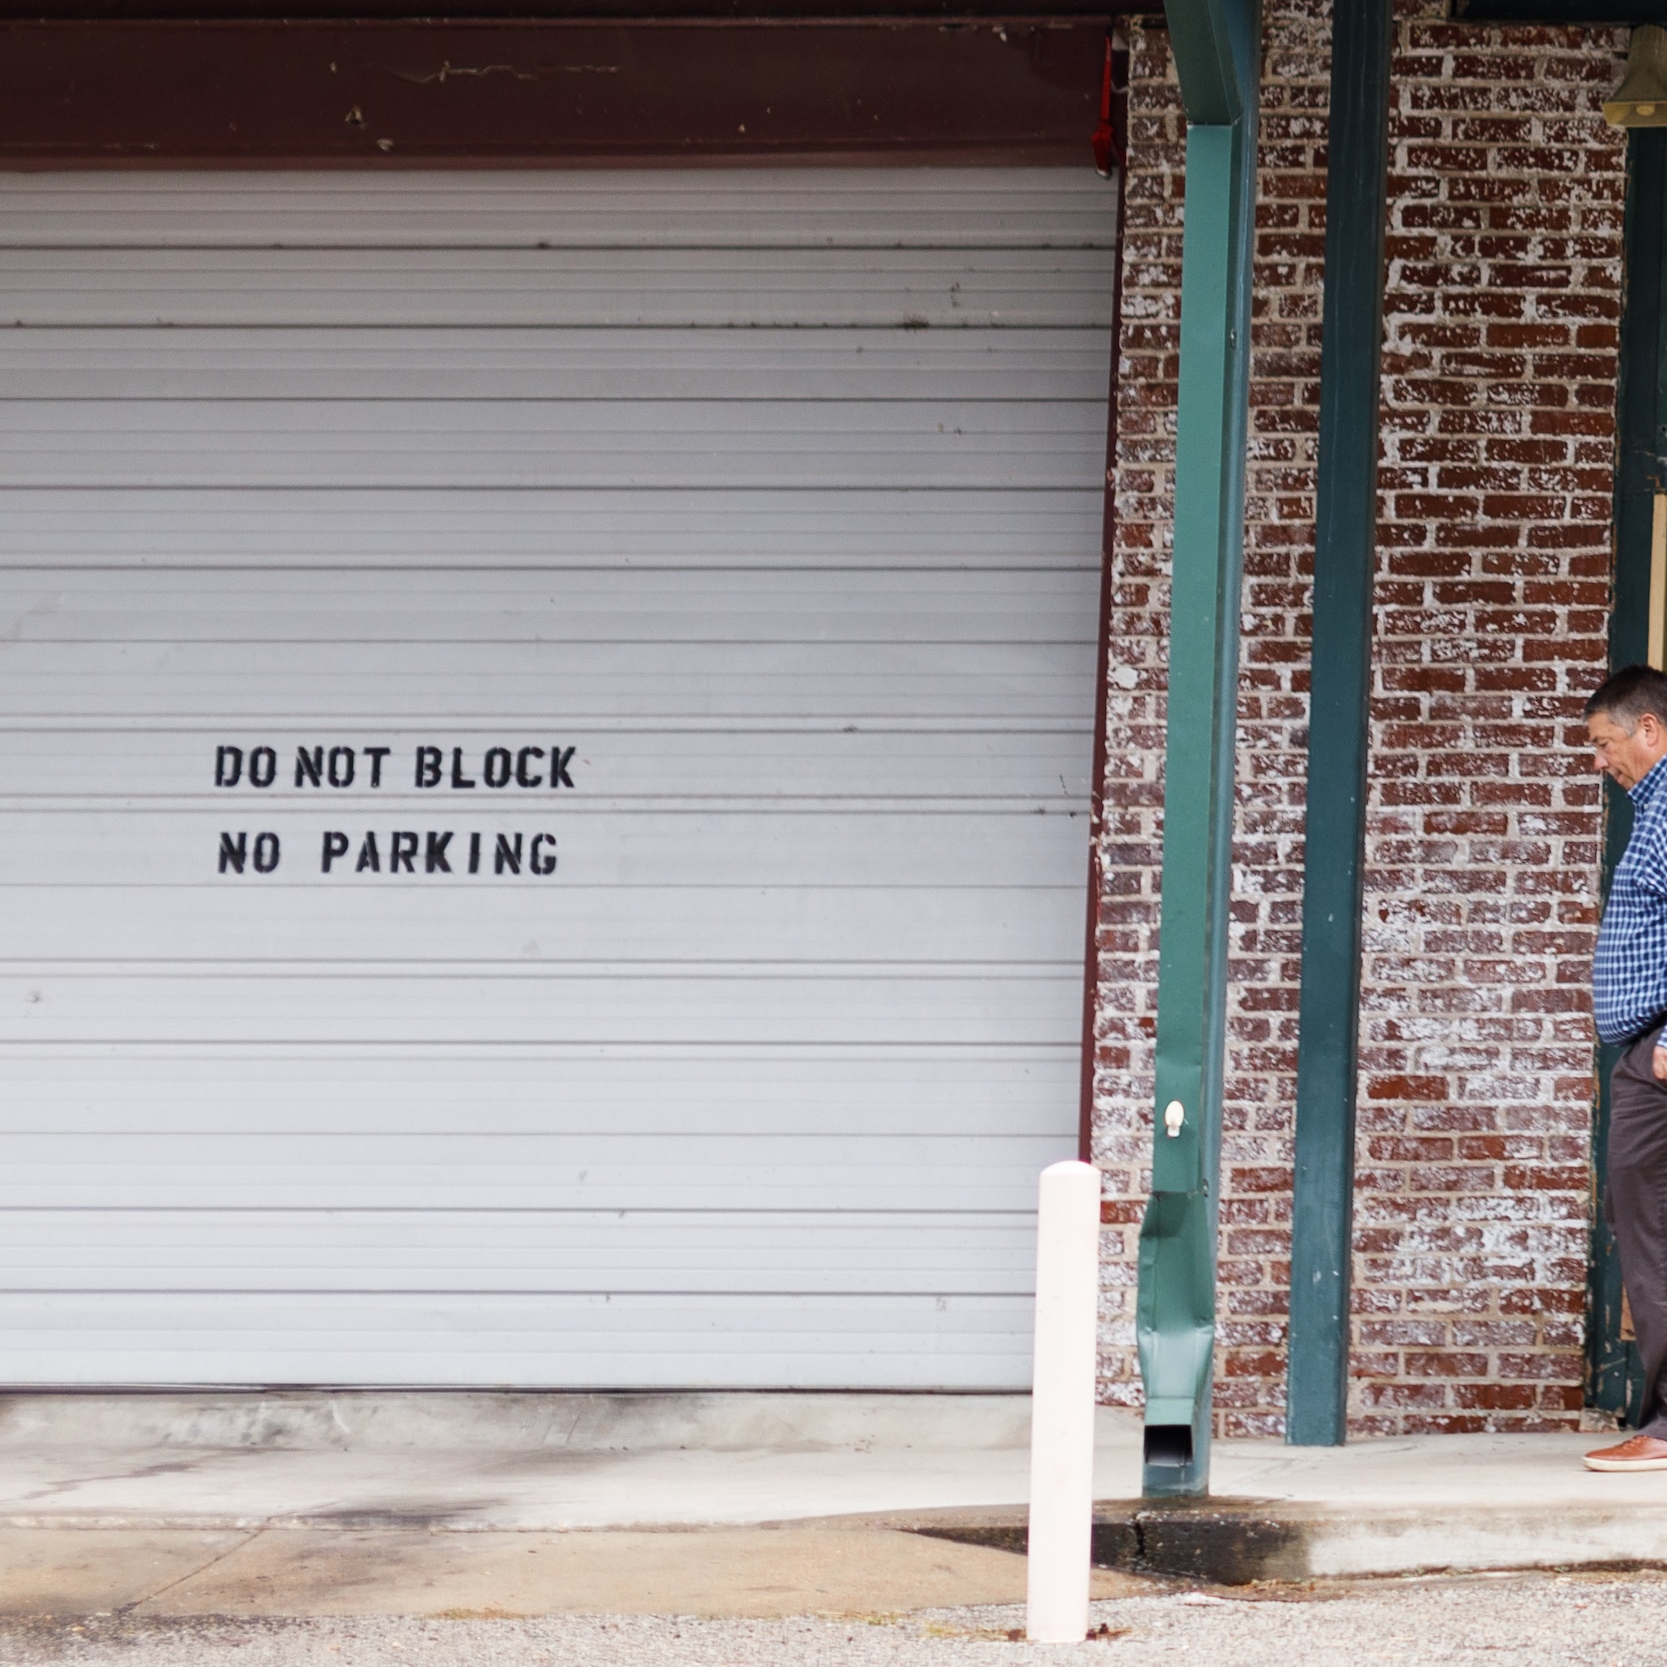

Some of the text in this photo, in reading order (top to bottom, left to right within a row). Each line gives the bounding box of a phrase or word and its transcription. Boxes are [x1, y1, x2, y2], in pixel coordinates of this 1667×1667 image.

[214, 745, 577, 789] DO NOT BLOCK
[217, 830, 557, 876] NO PARKING
